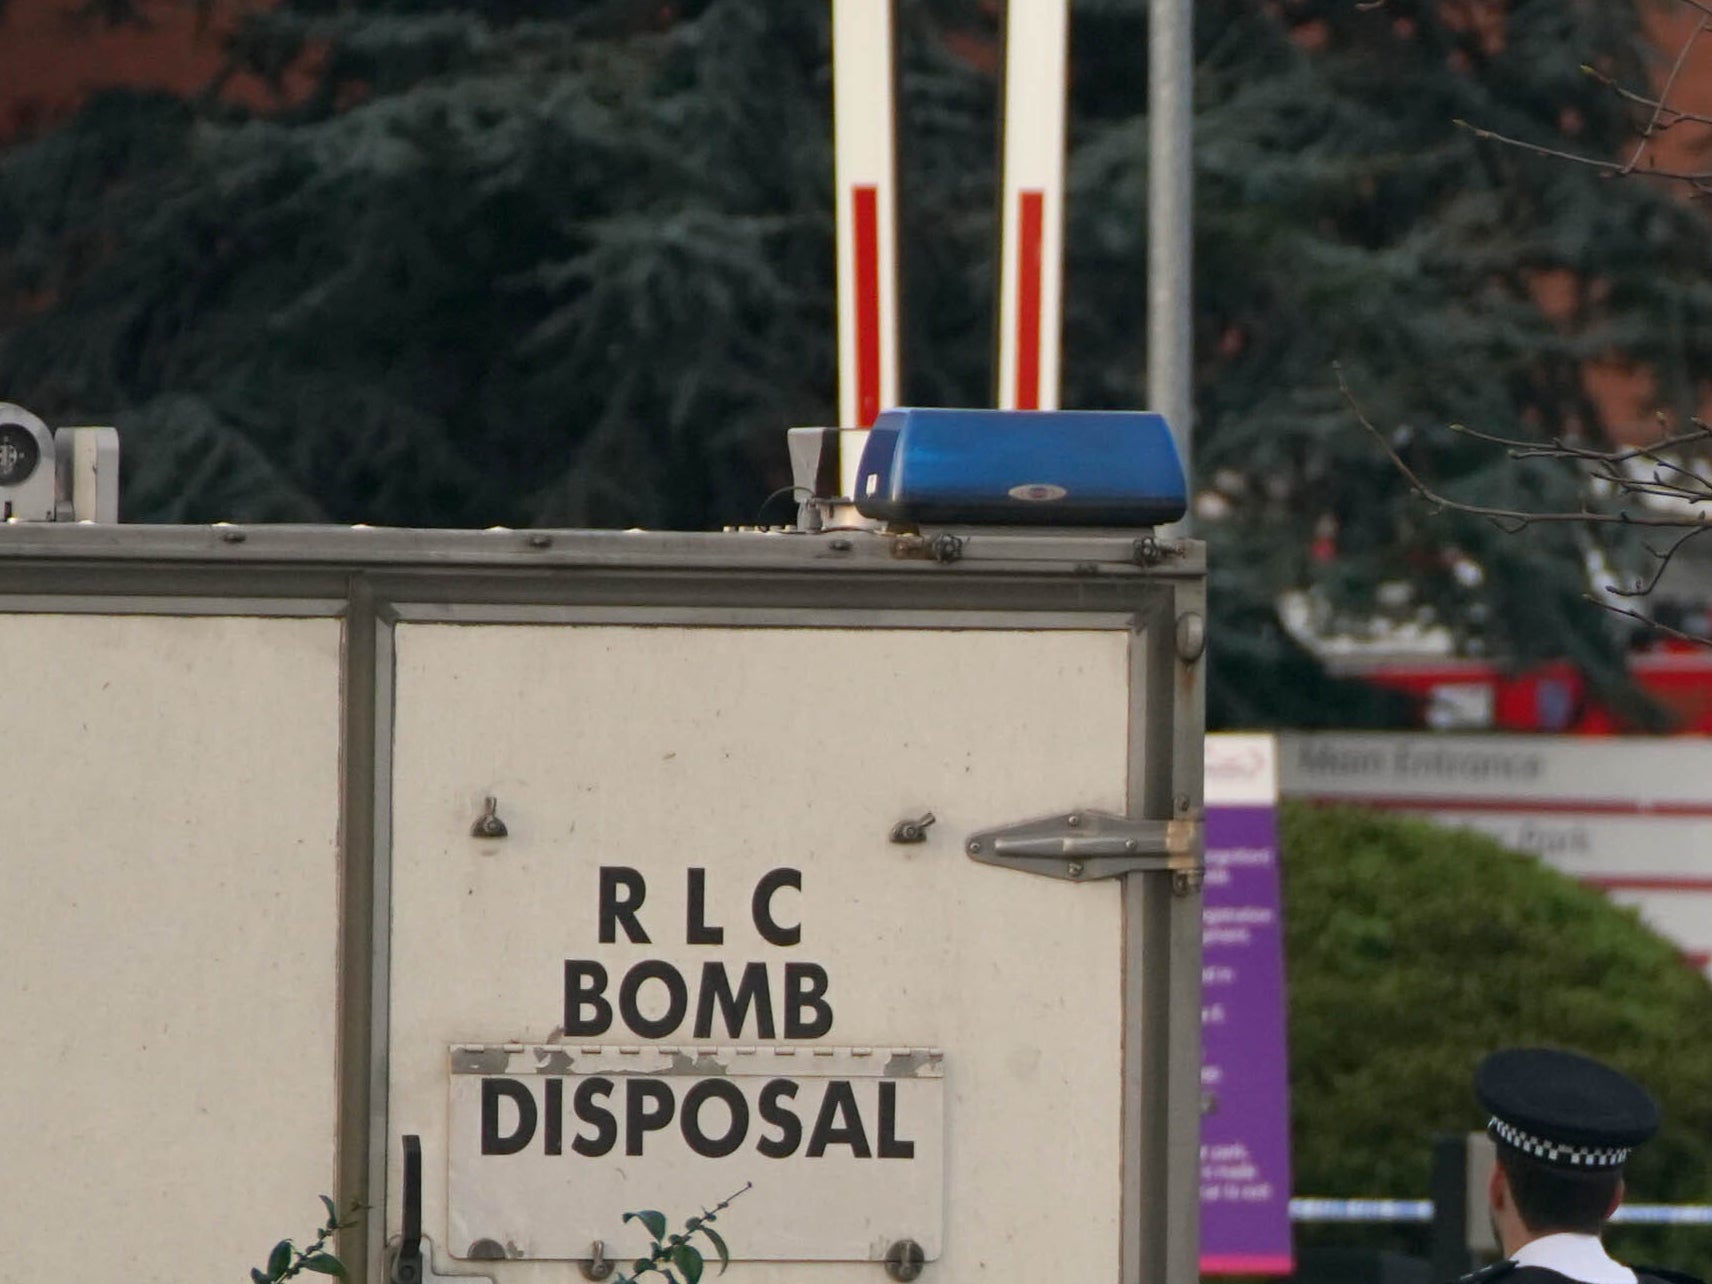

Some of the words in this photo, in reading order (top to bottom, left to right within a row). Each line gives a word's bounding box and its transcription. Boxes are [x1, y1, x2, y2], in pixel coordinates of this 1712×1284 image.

[598, 866, 652, 945] R
[686, 867, 724, 945] L
[752, 867, 802, 947] C
[563, 959, 834, 1040] BOMB
[480, 1077, 915, 1160] DISPOSAL
